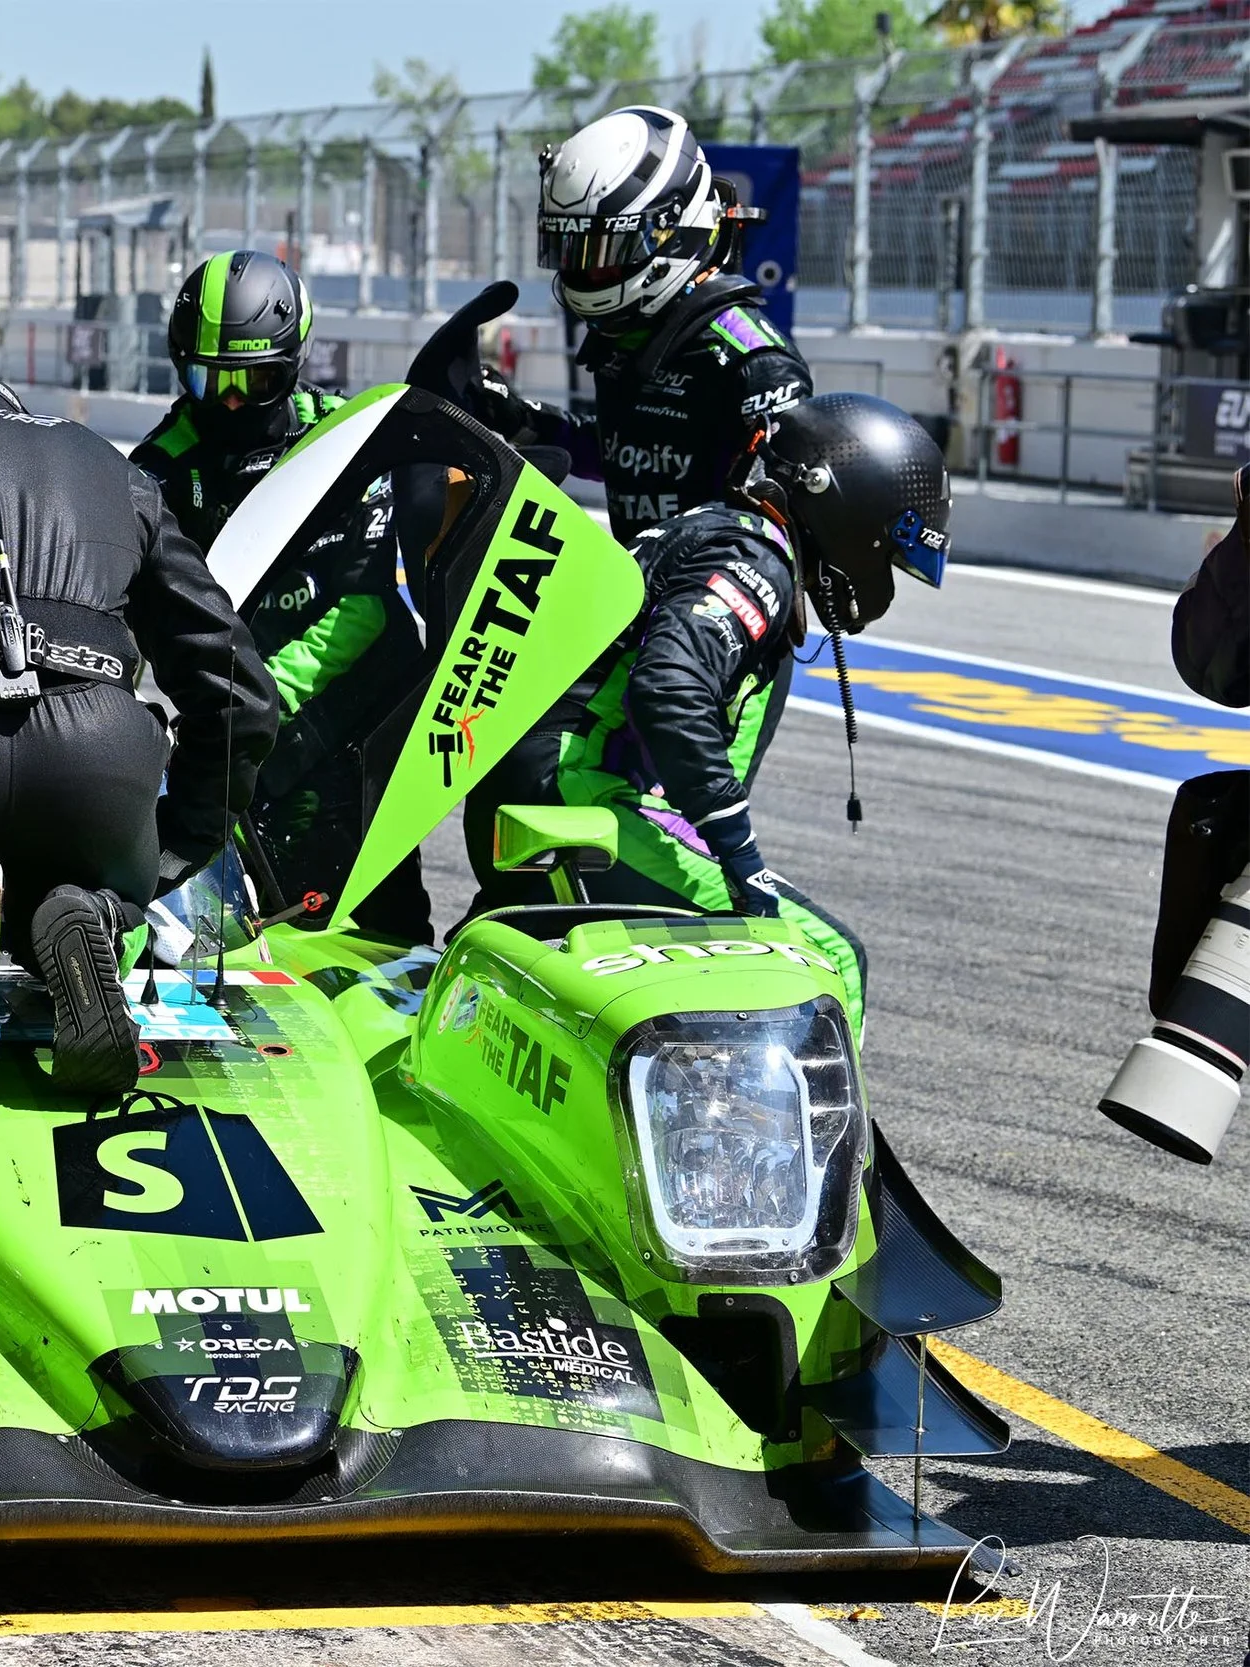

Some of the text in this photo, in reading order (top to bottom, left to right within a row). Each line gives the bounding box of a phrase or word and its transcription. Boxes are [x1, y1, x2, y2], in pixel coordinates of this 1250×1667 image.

[557, 218, 592, 232] TAF
[605, 215, 642, 229] TDS
[618, 493, 679, 520] TAF
[432, 499, 565, 728] FEAR TAF
[471, 645, 517, 709] THE
[582, 940, 837, 976] shop
[478, 995, 573, 1116] FEAR TAF
[482, 1036, 505, 1078] THE
[96, 1131, 184, 1214] S
[419, 1224, 550, 1237] PATRIMOINE
[130, 1288, 311, 1315] MOTUL
[200, 1338, 296, 1352] ORECA
[461, 1317, 630, 1366] Bastide
[553, 1359, 637, 1385] MEDICAL
[184, 1376, 302, 1401] TDS
[213, 1400, 296, 1413] RACING
